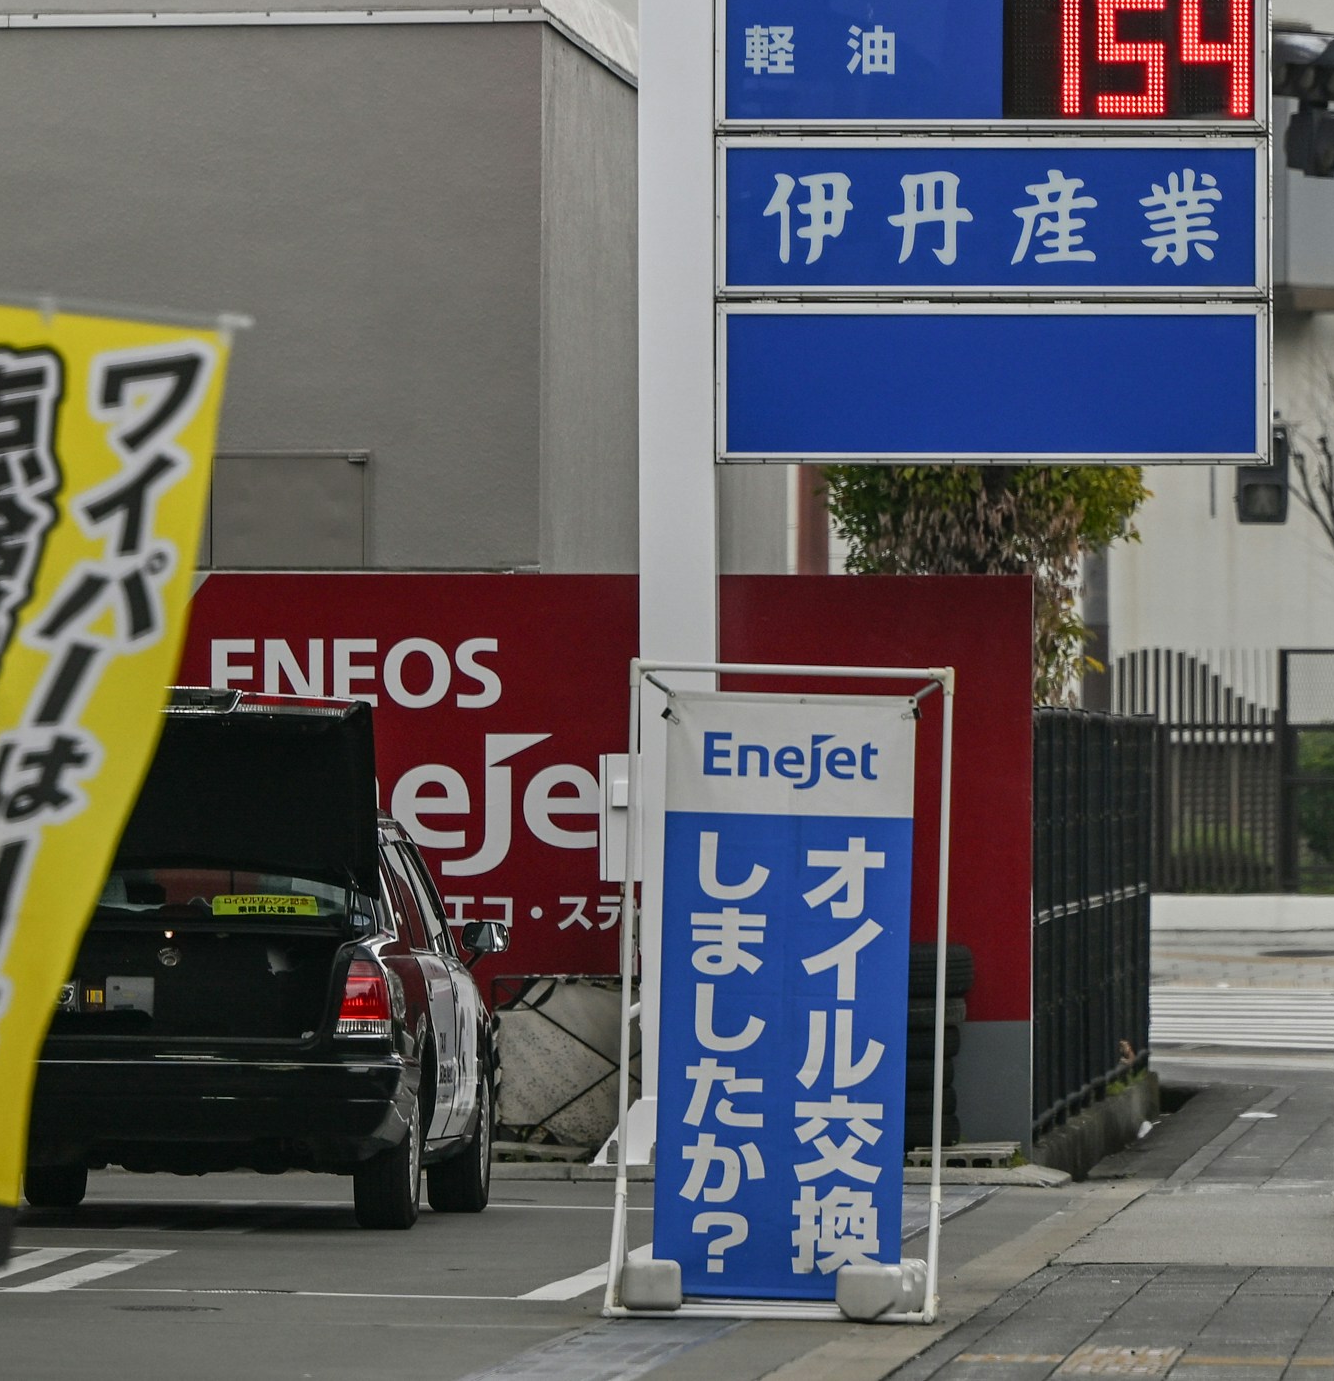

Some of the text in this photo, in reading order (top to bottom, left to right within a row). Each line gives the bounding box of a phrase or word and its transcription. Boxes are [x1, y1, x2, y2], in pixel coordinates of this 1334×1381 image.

[745, 25, 895, 75] 軽油
[762, 168, 1222, 267] 伊丹産業
[211, 639, 502, 709] ENEOS
[376, 733, 599, 876] eje
[702, 731, 879, 790] Enejet
[678, 831, 771, 1273] しましたか?
[791, 836, 886, 1276] オイル交換
